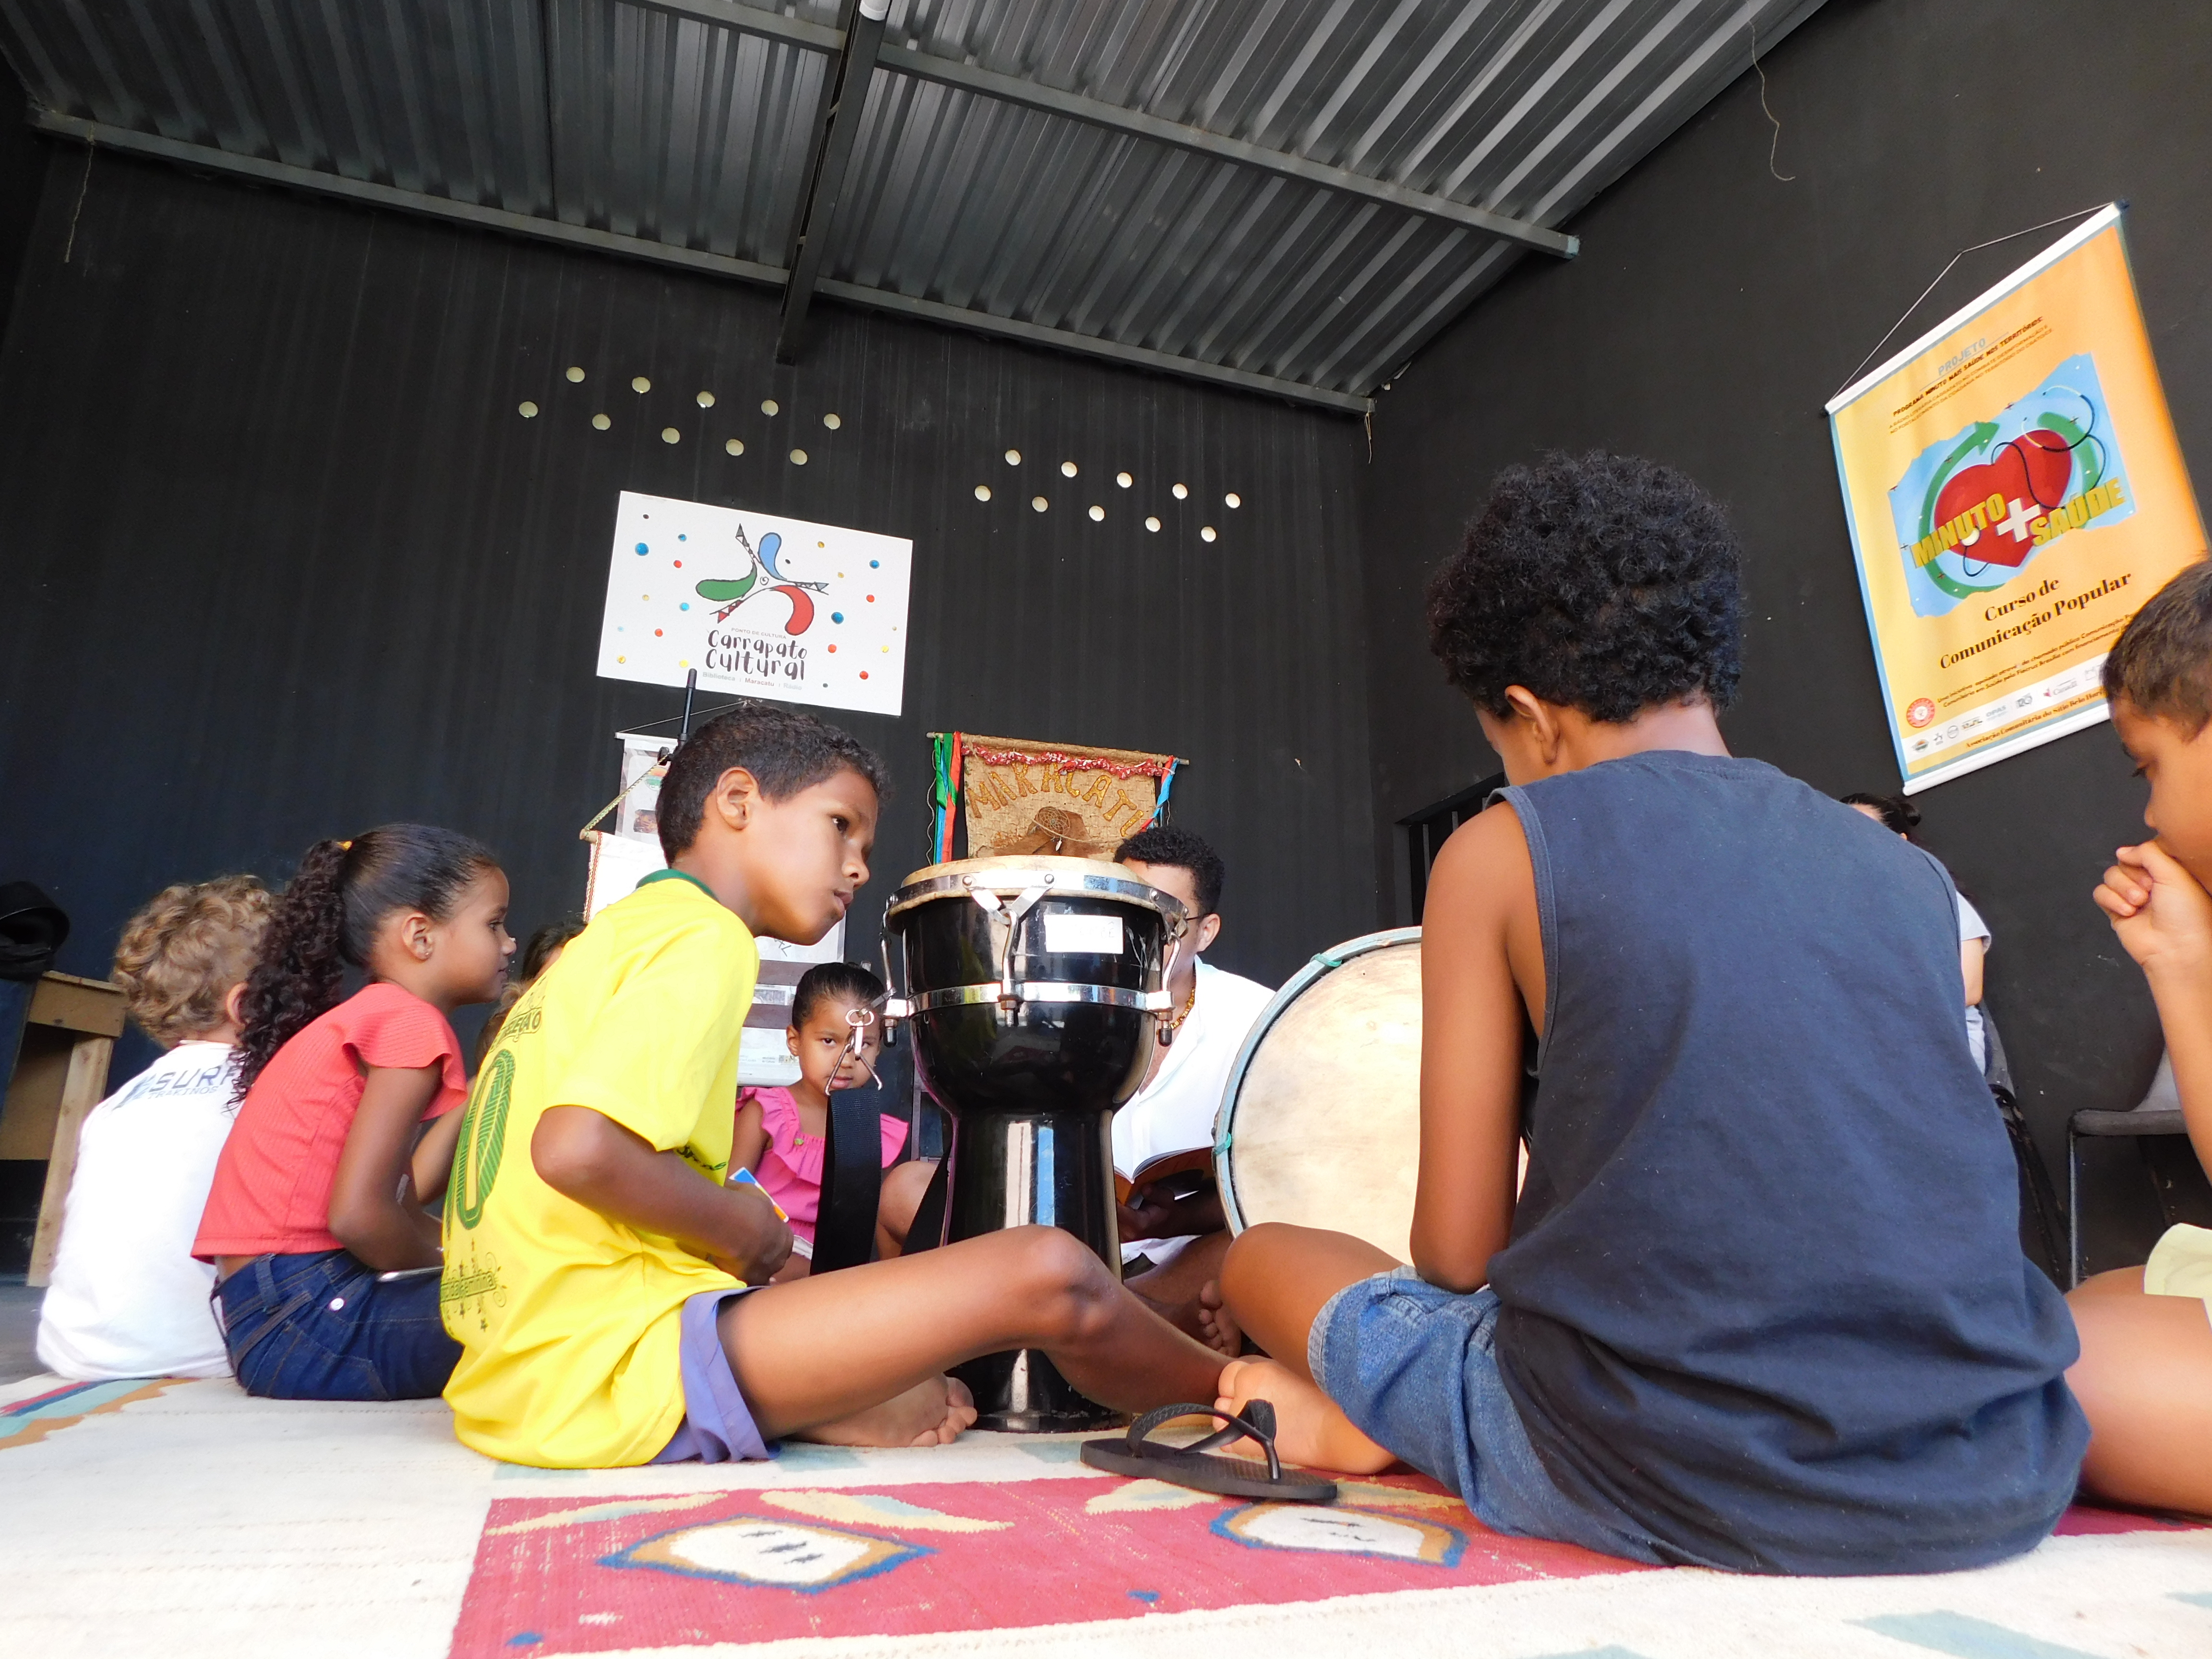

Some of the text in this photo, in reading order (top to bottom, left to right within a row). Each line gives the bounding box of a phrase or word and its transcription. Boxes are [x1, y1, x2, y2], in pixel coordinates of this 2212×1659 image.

[1938, 338, 1985, 375] PROJETO
[1910, 493, 2007, 569] MINUTO
[2030, 477, 2126, 546] SAÚDE
[1984, 579, 2060, 622] Curso de
[708, 630, 807, 659] Carrapato
[1940, 613, 2051, 669] Comunicação
[702, 672, 735, 681] Biblioteca
[745, 677, 775, 686] Maracatu
[705, 649, 805, 681] Cultural
[149, 1065, 242, 1093] SURF
